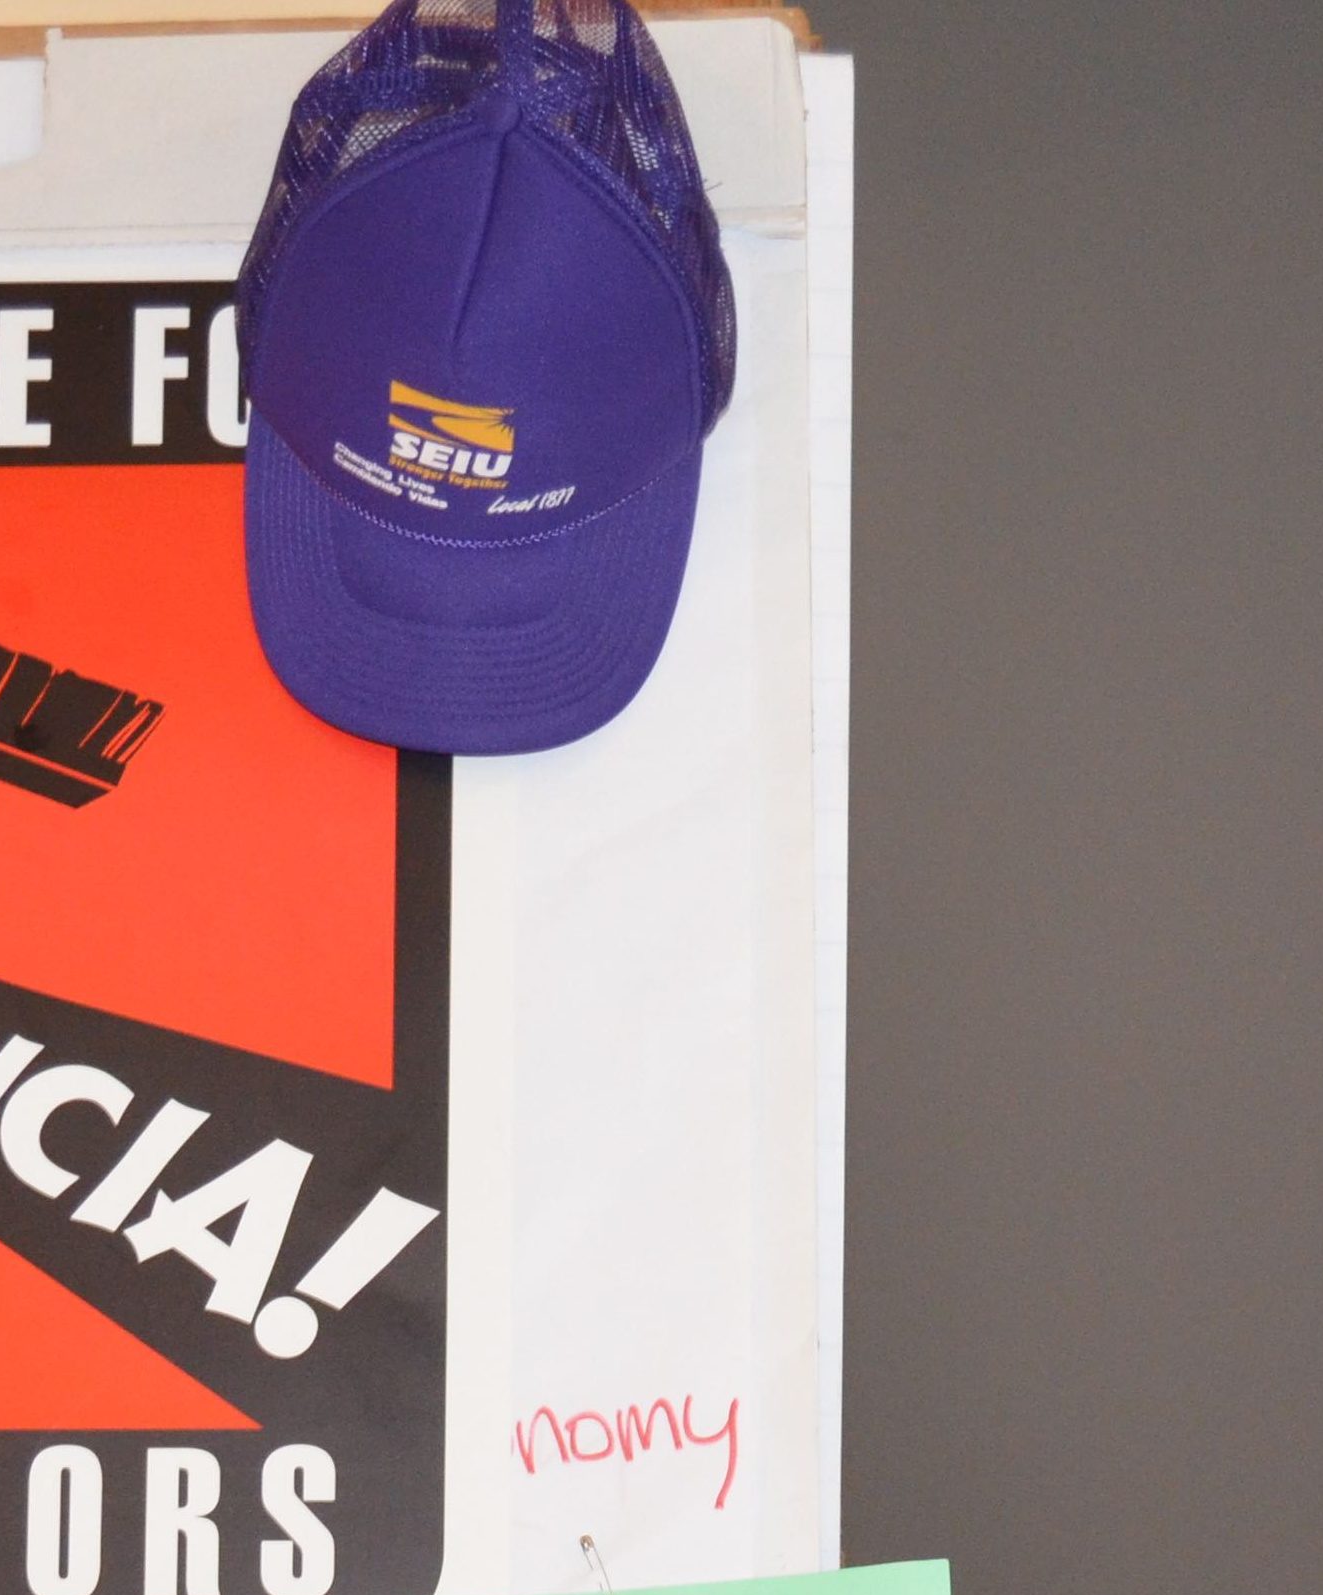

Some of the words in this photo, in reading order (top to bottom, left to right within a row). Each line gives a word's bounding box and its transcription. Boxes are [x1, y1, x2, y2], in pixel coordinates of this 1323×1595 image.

[131, 306, 251, 448] FO
[334, 441, 392, 482] Changing
[398, 474, 436, 494] Lives
[388, 454, 445, 481] Stronger
[449, 474, 509, 490] Together
[390, 430, 513, 478] SEIU
[409, 490, 448, 510] Vidas
[486, 492, 537, 514] Local
[538, 486, 576, 510] 1877
[514, 1394, 739, 1510] nomy
